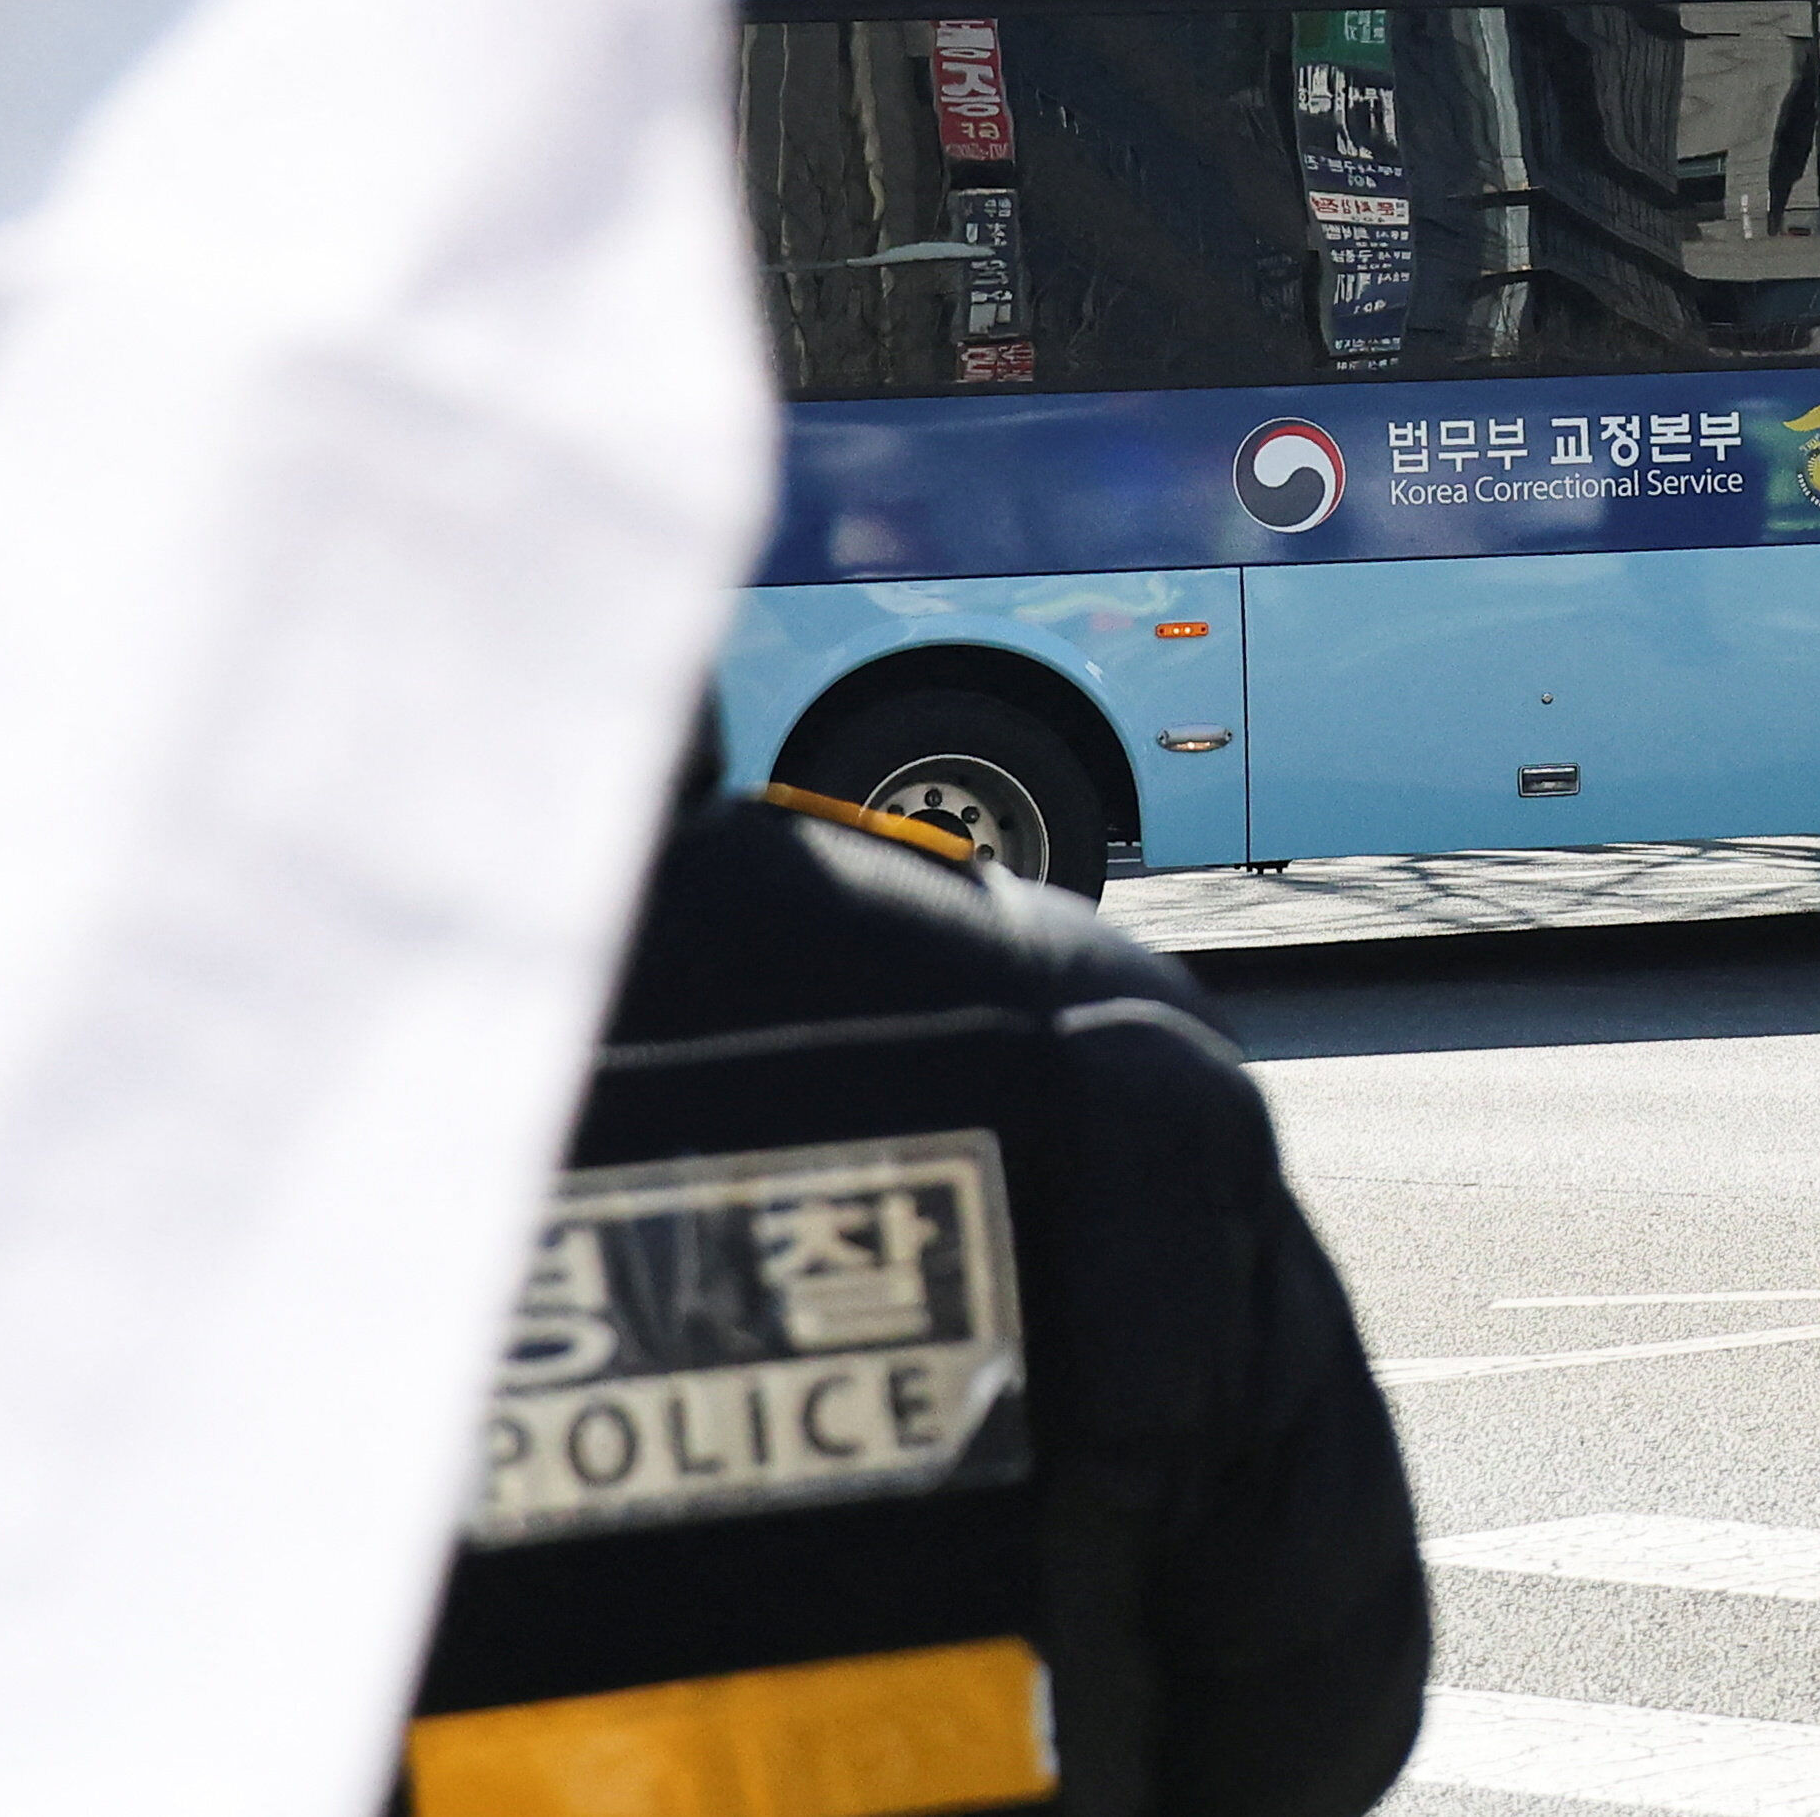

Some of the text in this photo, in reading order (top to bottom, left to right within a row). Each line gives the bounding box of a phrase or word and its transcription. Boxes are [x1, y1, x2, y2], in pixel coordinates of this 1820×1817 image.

[1387, 410, 1743, 475] 법무부 교정본부
[1389, 467, 1744, 507] Korea Correctional Service
